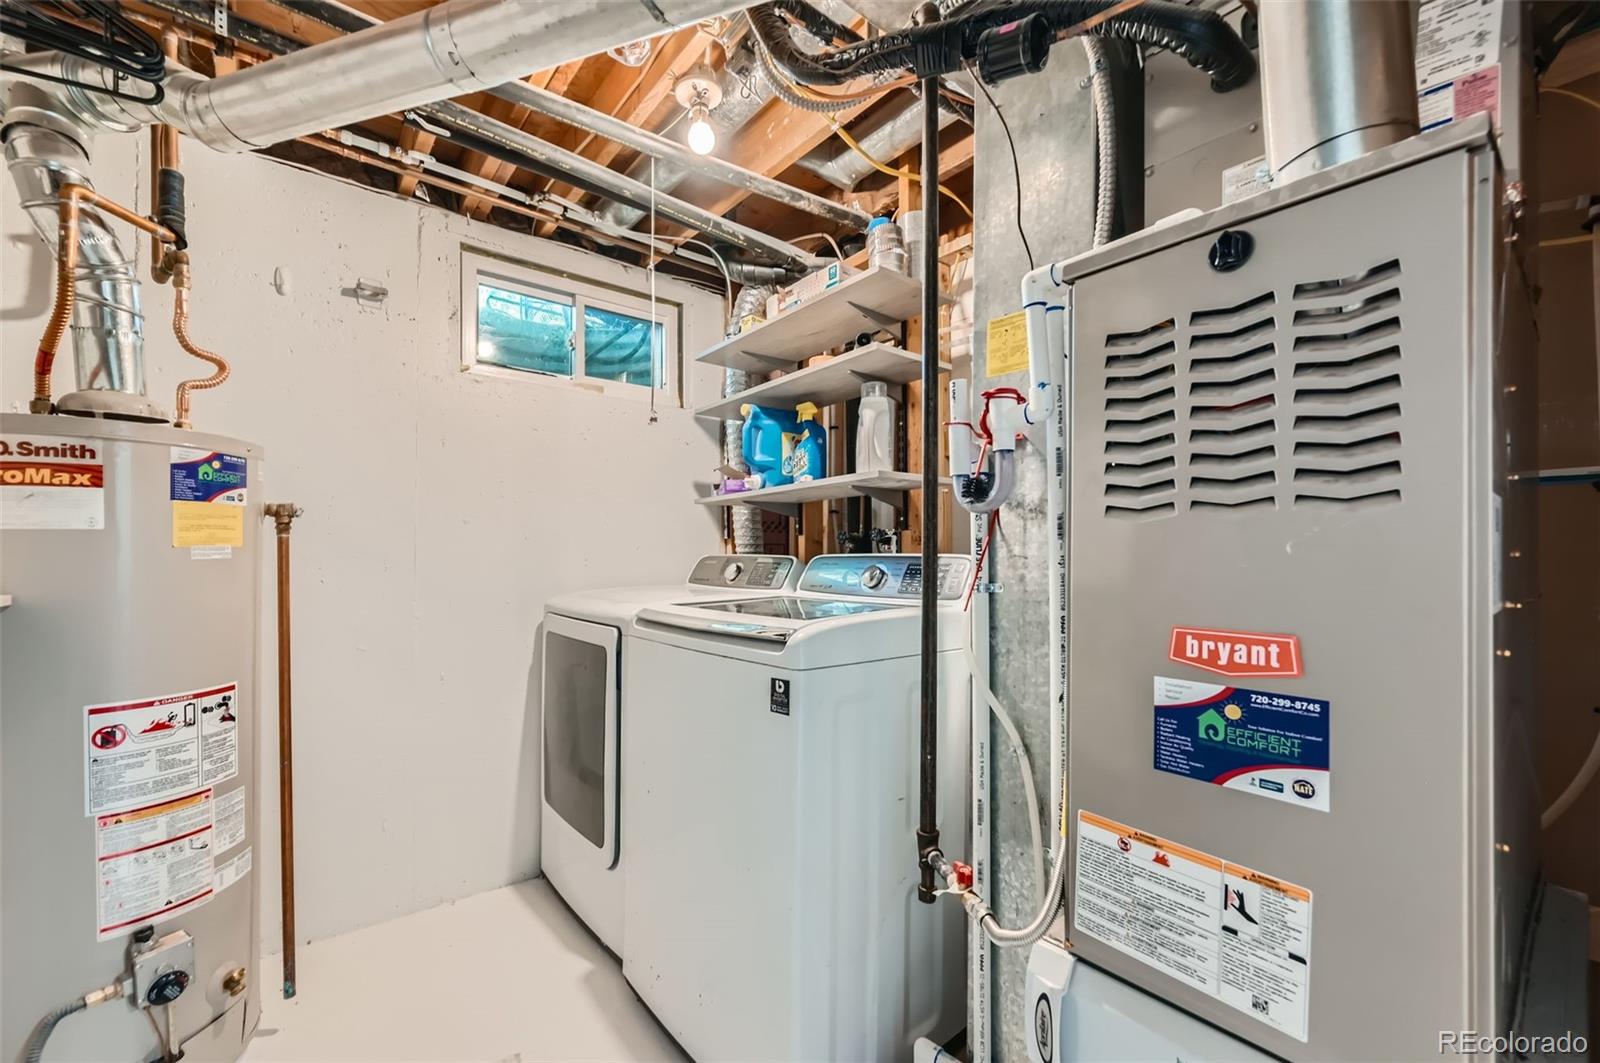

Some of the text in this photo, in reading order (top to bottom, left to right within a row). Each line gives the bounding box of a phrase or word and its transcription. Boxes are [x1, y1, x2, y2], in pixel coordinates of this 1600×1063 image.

[1186, 634, 1280, 668] bryant
[1250, 694, 1320, 712] 720-299-8745
[1227, 727, 1302, 748] EFFICIENT
[1227, 736, 1302, 757] COMFORT
[1294, 782, 1313, 796] NATE
